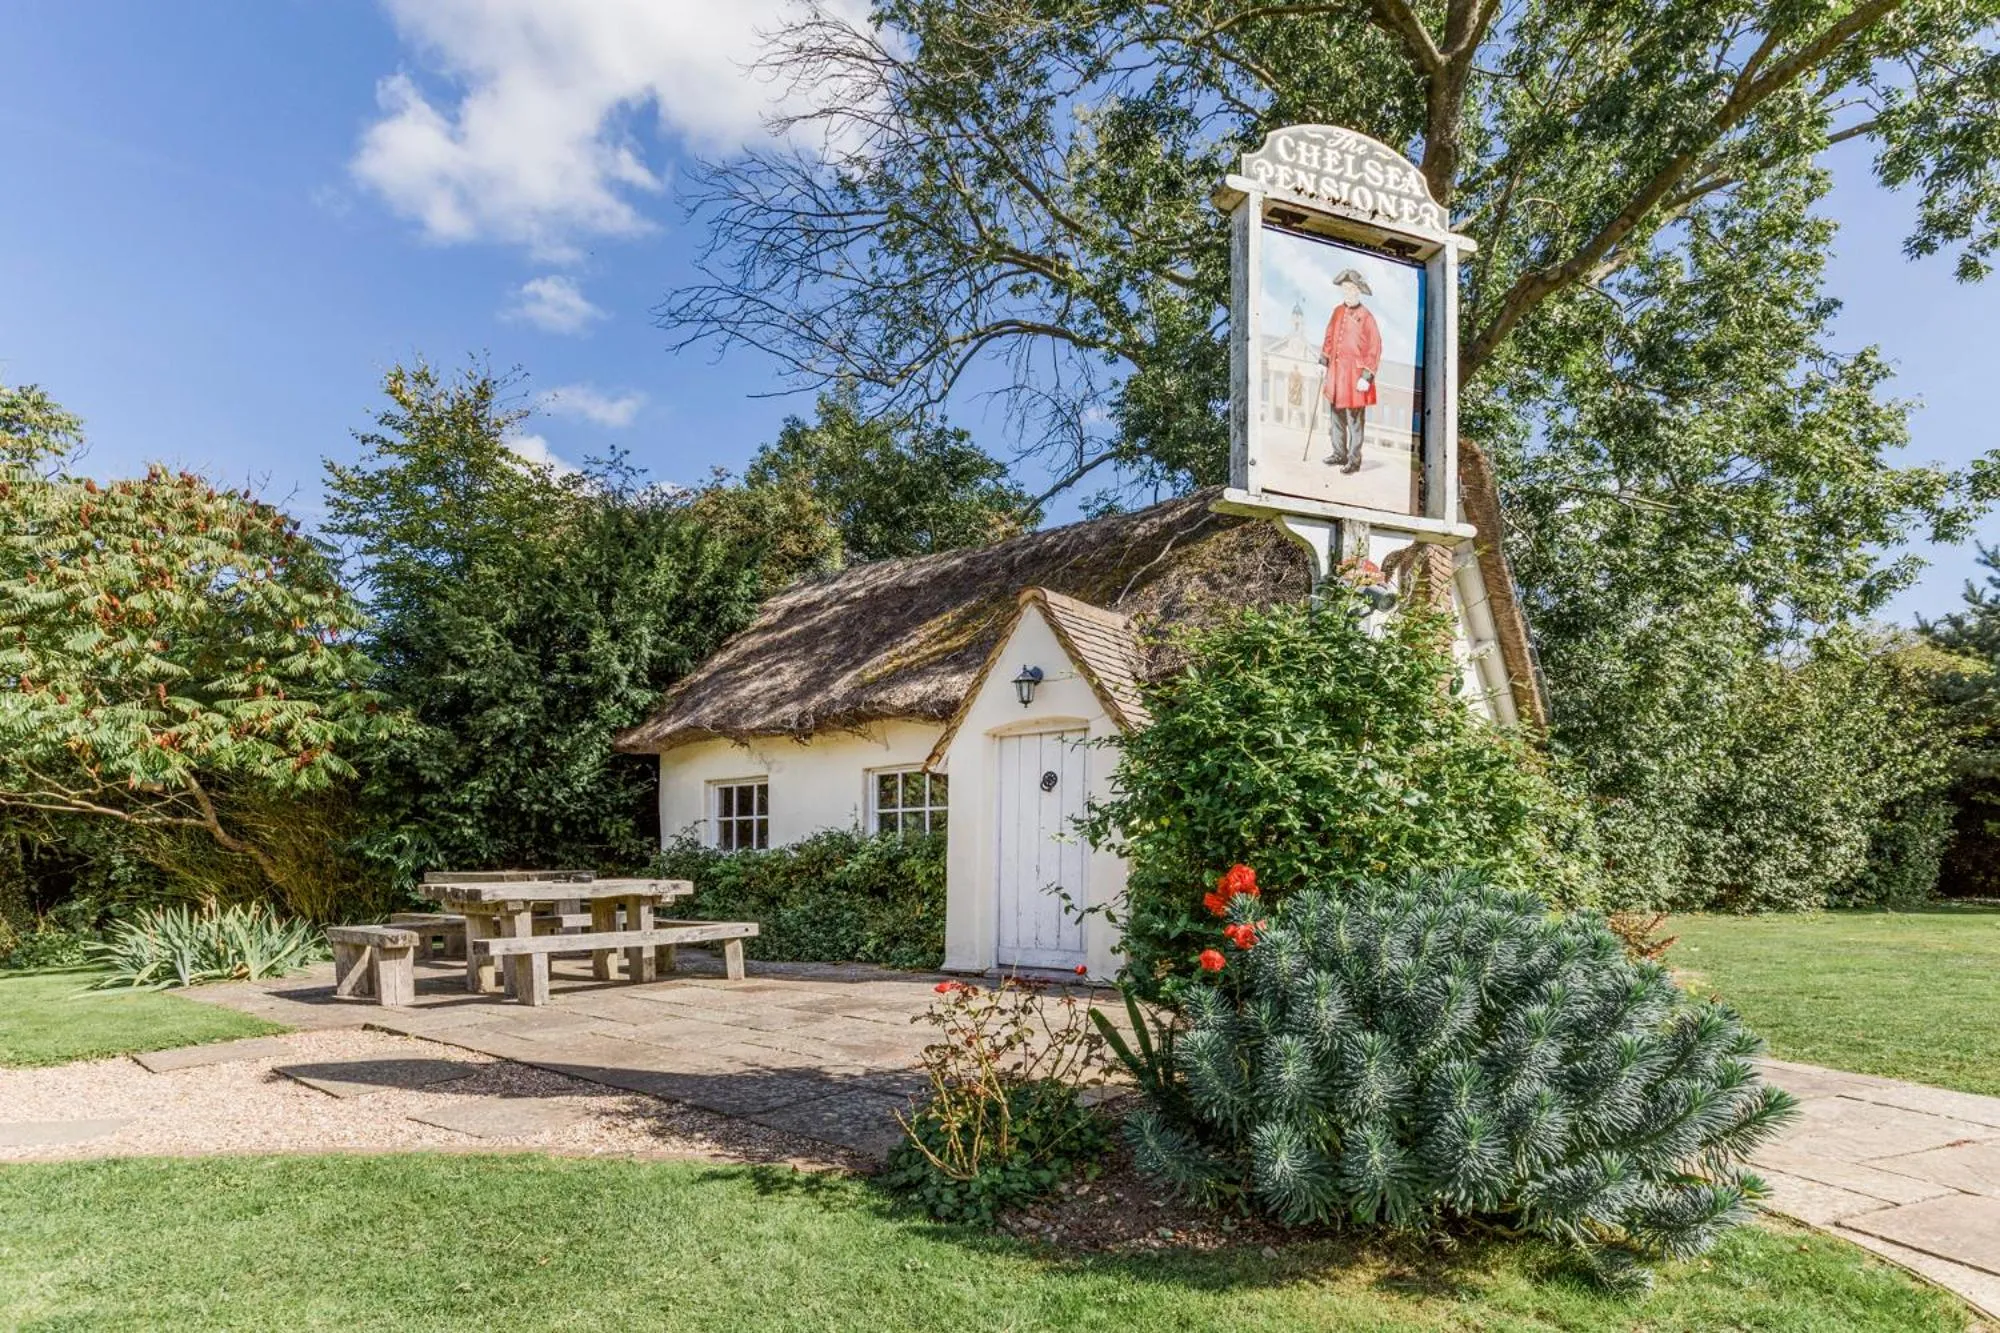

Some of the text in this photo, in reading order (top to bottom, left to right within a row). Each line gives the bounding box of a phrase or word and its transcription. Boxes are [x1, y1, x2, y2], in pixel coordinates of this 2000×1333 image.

[1276, 135, 1425, 199] CHELSEA
[1327, 131, 1367, 155] The
[1253, 159, 1446, 234] PENSIONER
